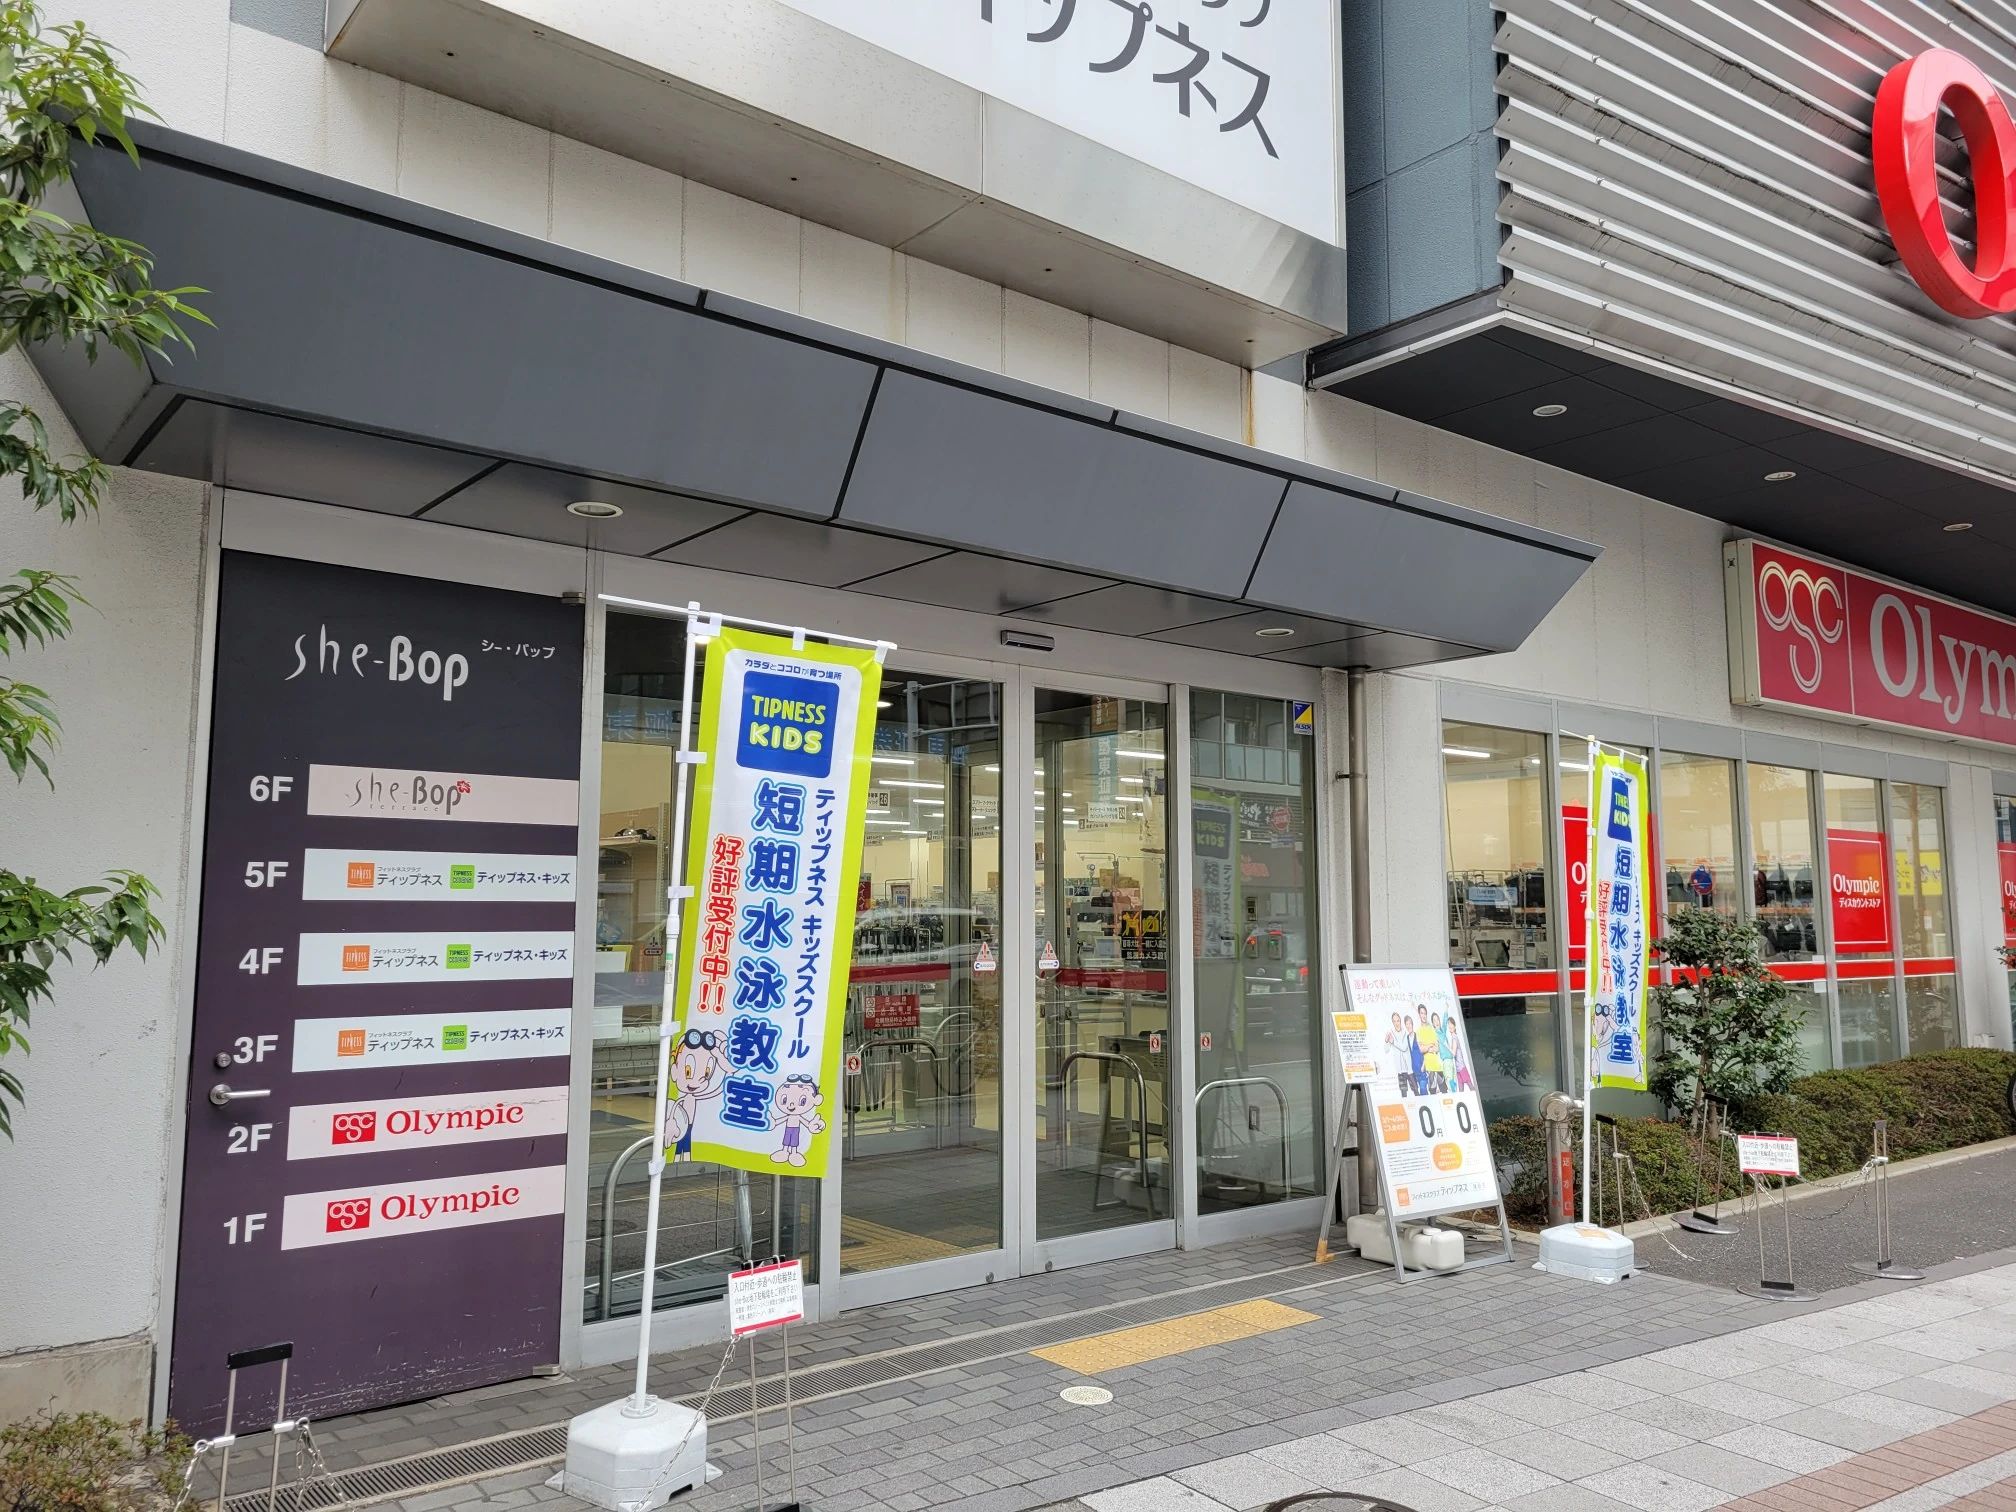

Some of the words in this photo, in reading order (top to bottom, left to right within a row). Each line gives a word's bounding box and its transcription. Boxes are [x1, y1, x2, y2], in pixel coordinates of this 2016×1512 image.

[744, 659, 842, 680] カラダとココロが育つ場所
[752, 695, 826, 724] TIPNESS
[750, 722, 823, 754] KIDS
[249, 774, 294, 802] 6F
[805, 788, 835, 907] ティップネス
[244, 861, 289, 888] 5F
[377, 873, 443, 886] ティップネス
[477, 871, 571, 885] ティップネス・キッズ
[1833, 874, 1880, 895] Olympic
[238, 947, 284, 975] 4F
[372, 955, 439, 968] ティップネス
[473, 948, 568, 962] ティップネス・キッズ
[721, 779, 805, 1130] 短期水泳教室
[788, 914, 822, 1059] キッズスクール
[368, 1037, 434, 1051] ティップネス
[469, 1025, 565, 1043] ティップネス・キッズ
[233, 1035, 279, 1064] 3F
[386, 1102, 524, 1135] Olympic
[227, 1123, 273, 1154] 2F
[381, 1184, 520, 1220] Olympic
[224, 1213, 268, 1244] 1F
